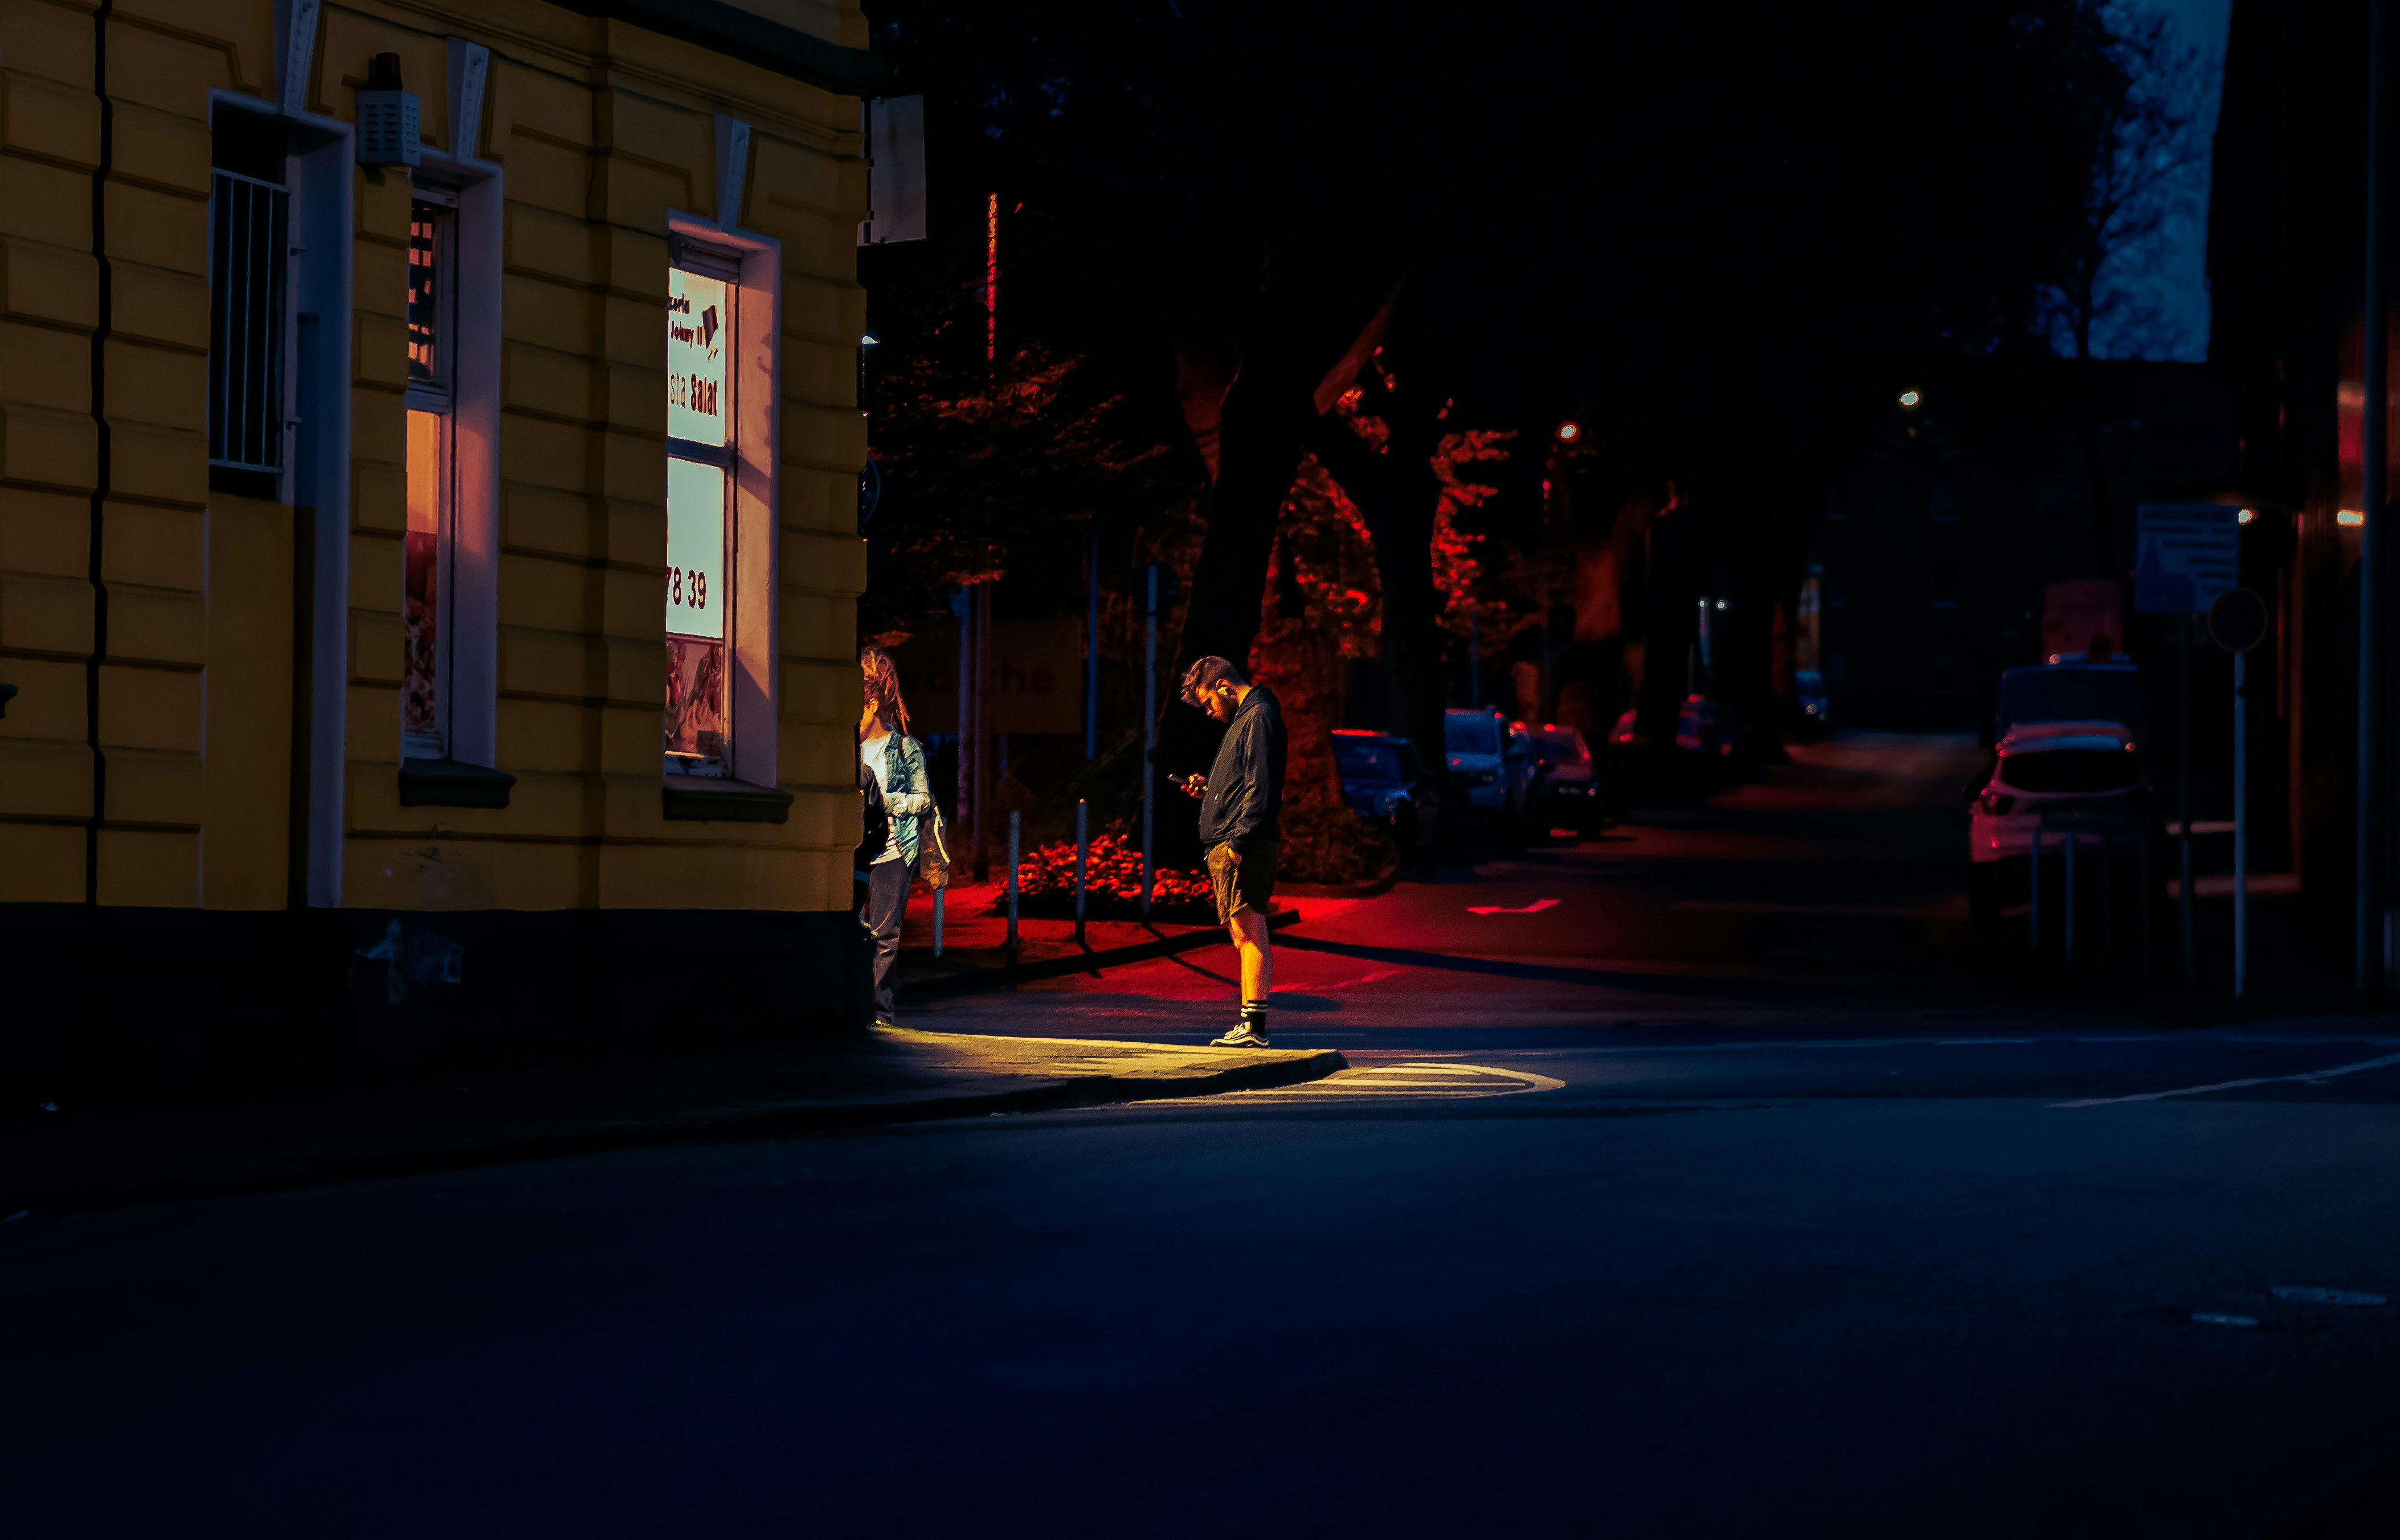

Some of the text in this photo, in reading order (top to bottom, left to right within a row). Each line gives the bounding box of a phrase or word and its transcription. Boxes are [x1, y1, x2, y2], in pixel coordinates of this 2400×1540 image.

[670, 371, 717, 416] sta Salat
[688, 570, 706, 609] 39
